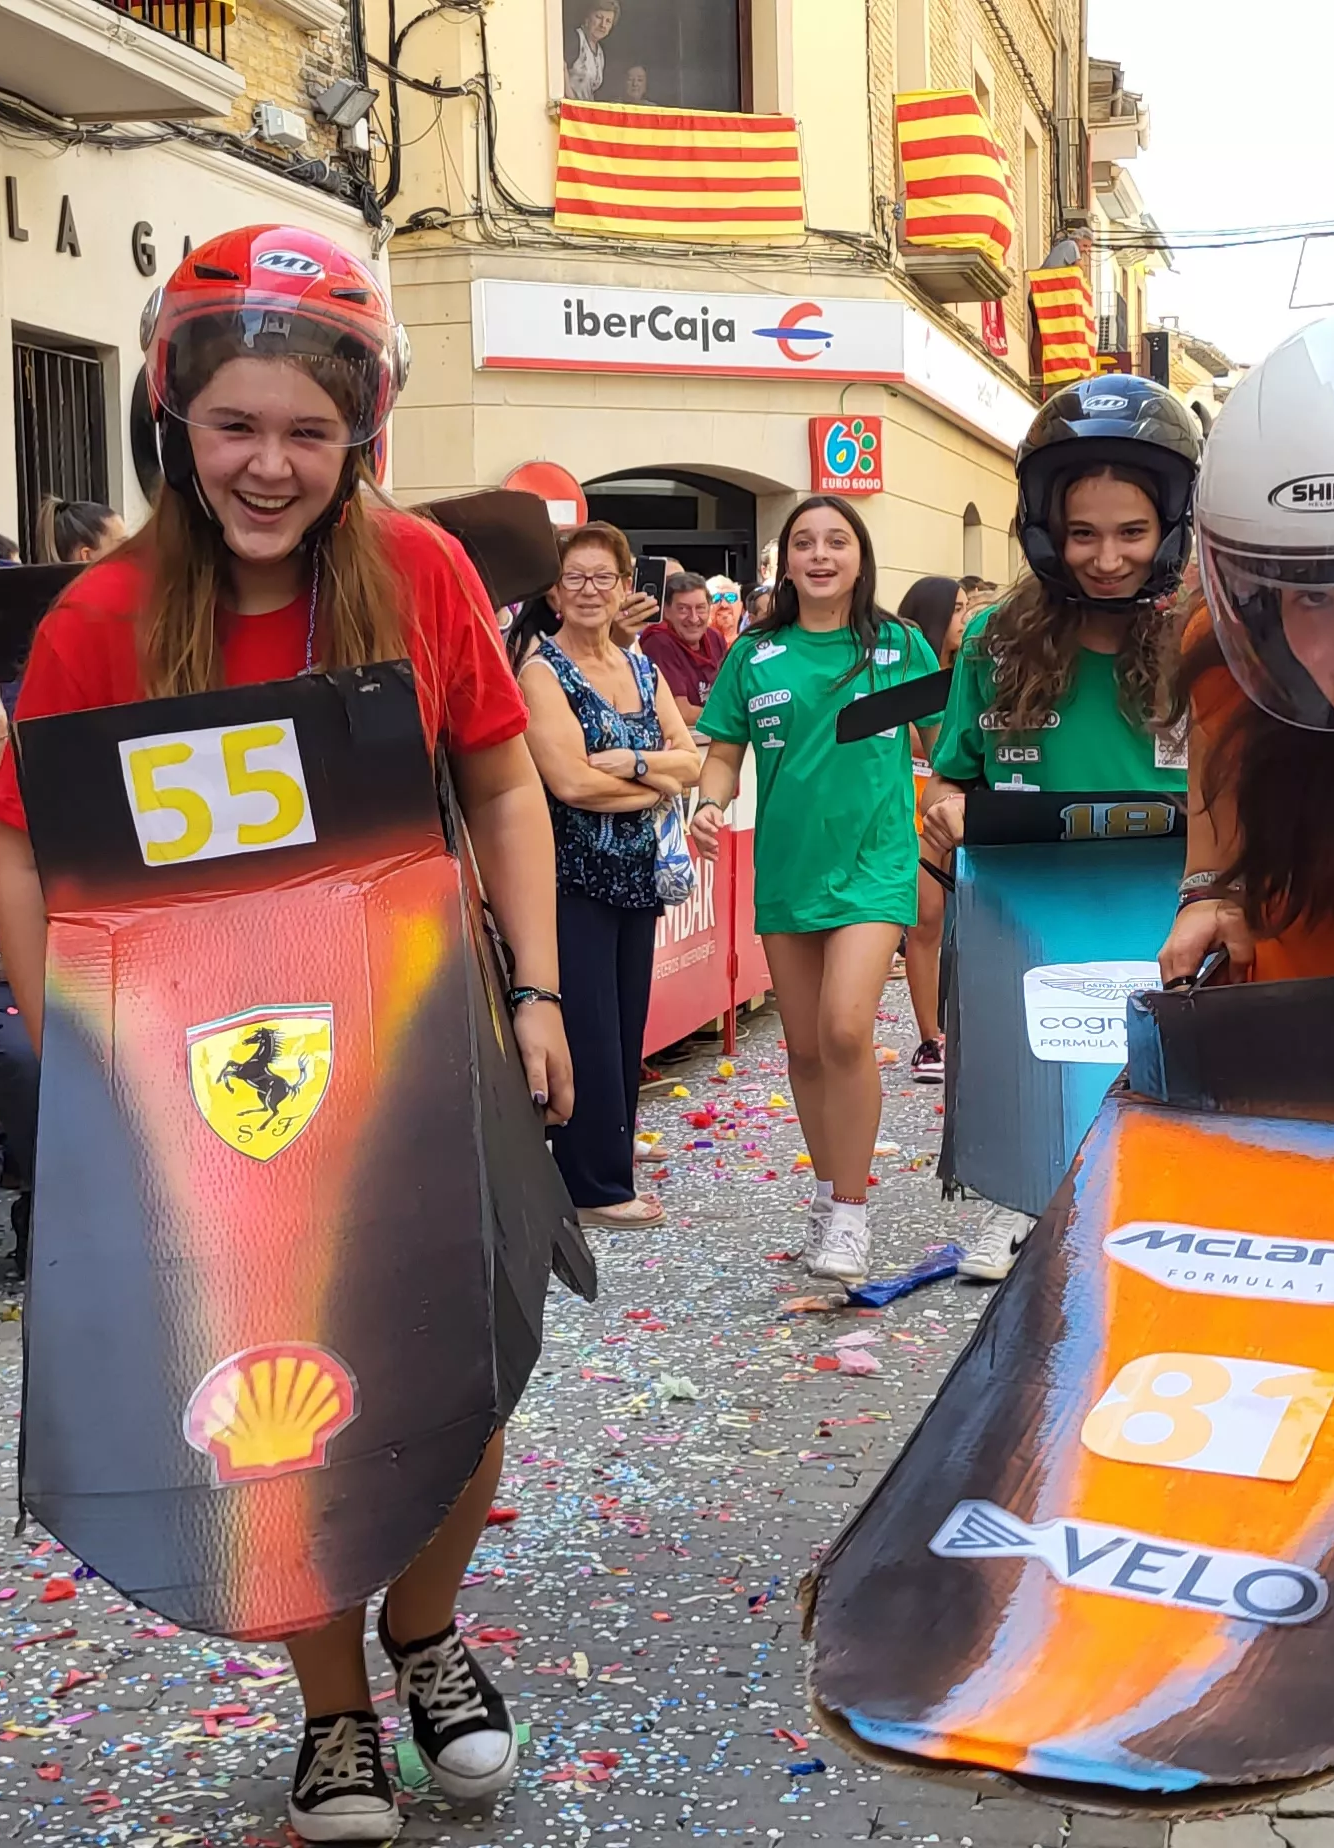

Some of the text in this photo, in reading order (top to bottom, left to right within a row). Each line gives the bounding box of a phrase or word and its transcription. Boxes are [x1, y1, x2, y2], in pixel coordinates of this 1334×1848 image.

[5, 176, 82, 258] LA
[563, 297, 736, 352] iberCaja
[821, 477, 882, 490] EURO 6000
[749, 691, 789, 711] aramco
[757, 717, 780, 728] JCB
[997, 748, 1039, 761] JCB
[129, 725, 305, 862] 55
[1060, 801, 1175, 841] 18
[1119, 981, 1155, 989] MARTIN
[1041, 1038, 1117, 1048] FORMULA
[1167, 1268, 1295, 1291] FORMULA
[1314, 1283, 1324, 1294] 1
[1064, 1524, 1320, 1617] VELO
